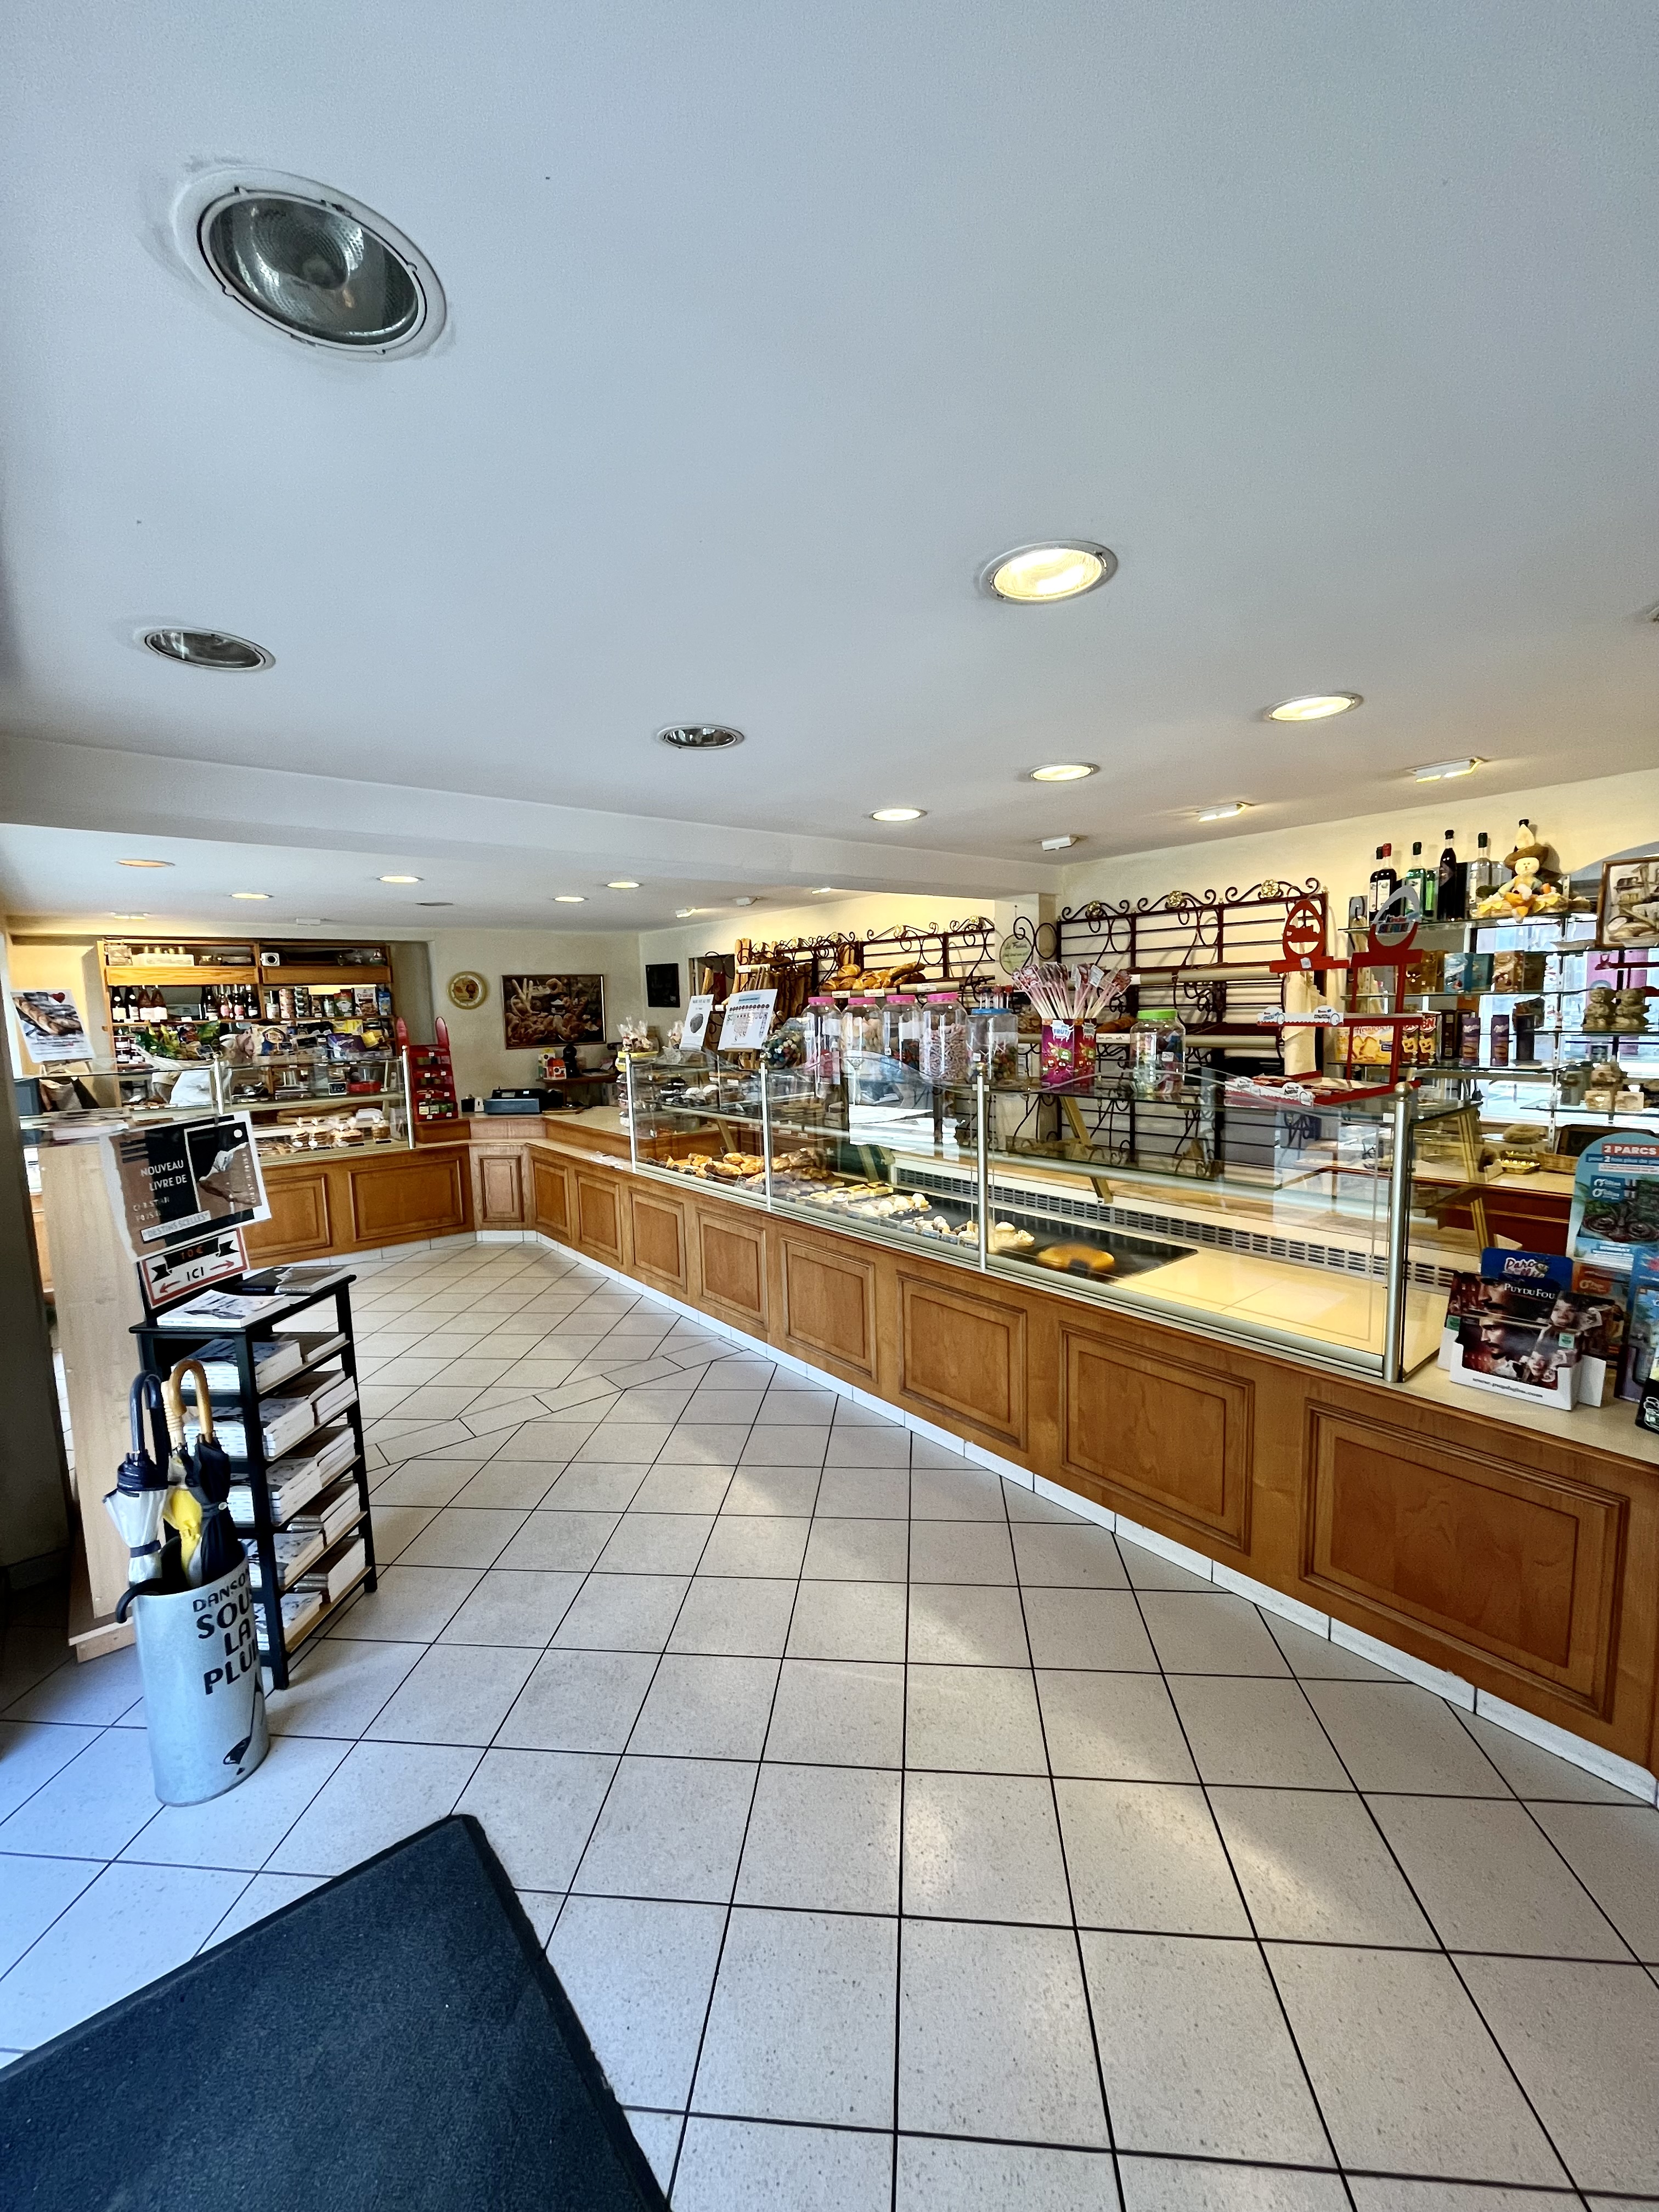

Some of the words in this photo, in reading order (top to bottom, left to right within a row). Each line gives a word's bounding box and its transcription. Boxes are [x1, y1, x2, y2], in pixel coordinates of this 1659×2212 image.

[1604, 1145, 1611, 1153] 2
[1614, 1146, 1657, 1155] PARCS
[140, 1159, 184, 1177] NOUVEAU
[149, 1177, 174, 1192] LIVRE
[176, 1174, 188, 1185] DE
[187, 1266, 204, 1282] ICI
[224, 1618, 251, 1656] LA
